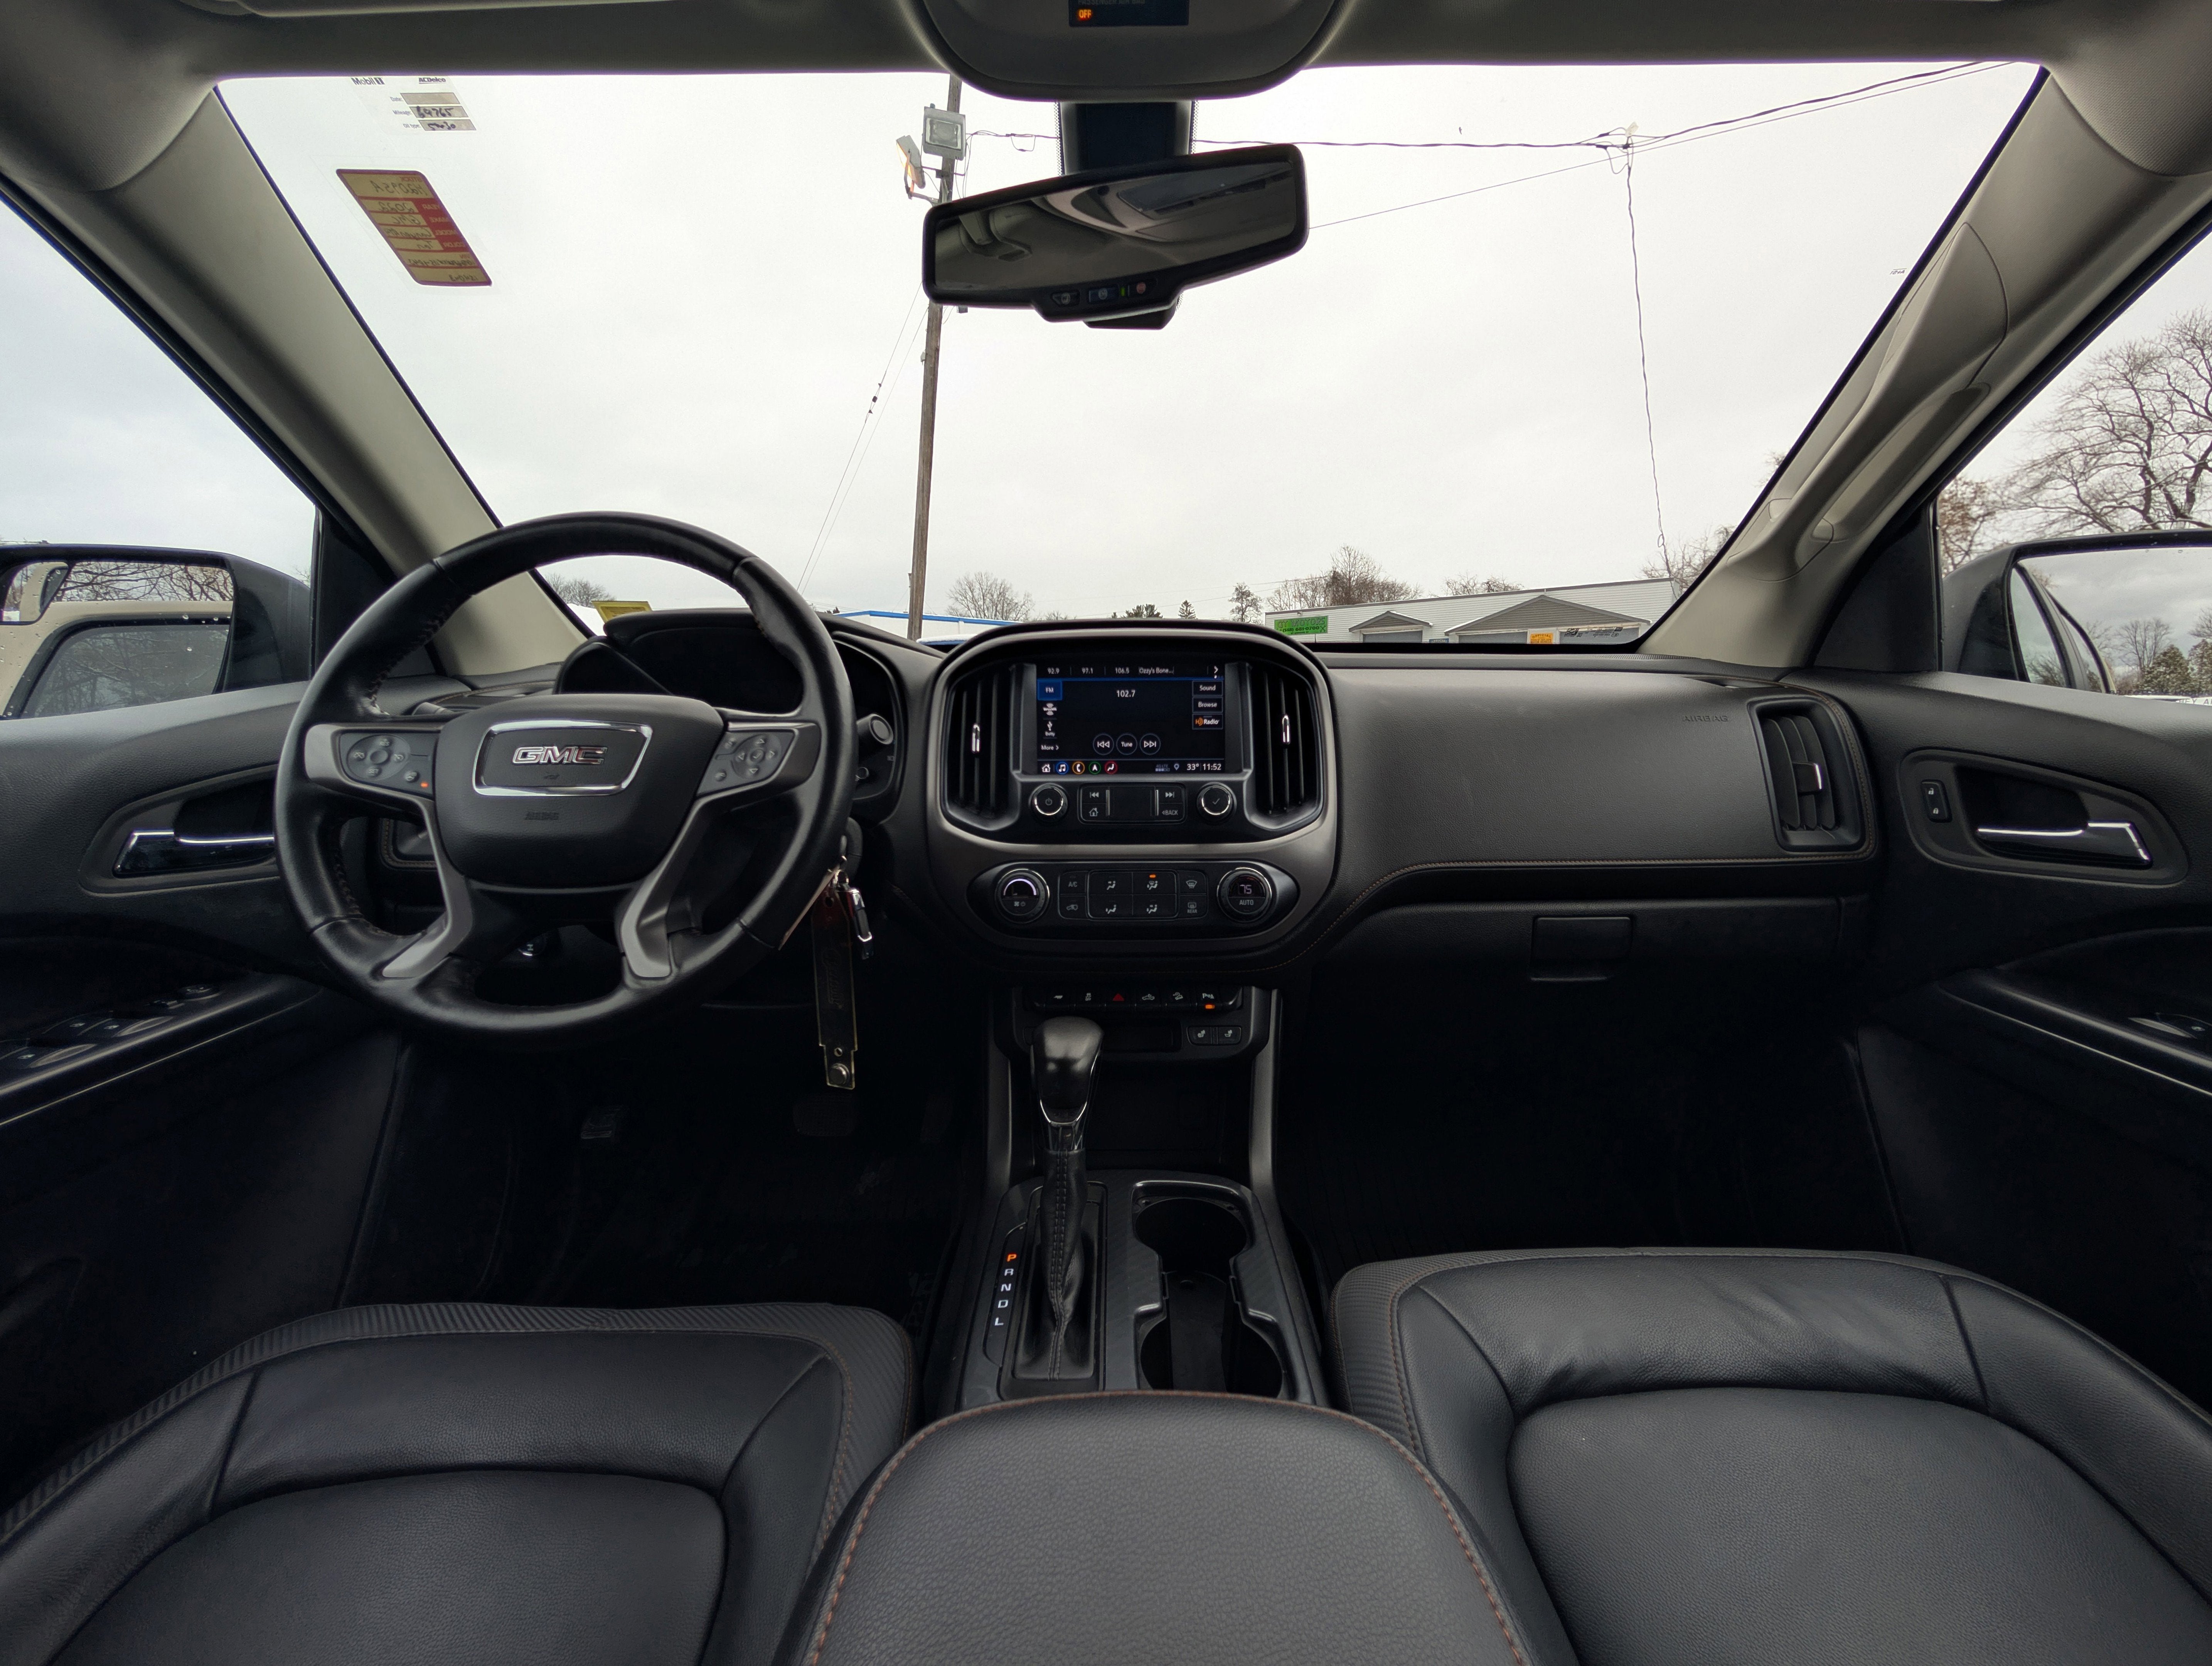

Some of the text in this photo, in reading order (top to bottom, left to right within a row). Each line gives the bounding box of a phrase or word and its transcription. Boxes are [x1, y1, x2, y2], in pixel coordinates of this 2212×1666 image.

[1079, 9, 1092, 18] OFF
[1291, 617, 1325, 627] MOTORS
[512, 745, 608, 765] GMC
[1240, 885, 1252, 894] 75
[1007, 1254, 1017, 1262] P
[1001, 1283, 1011, 1292] N
[997, 1300, 1008, 1309] D
[995, 1317, 1004, 1325] L
